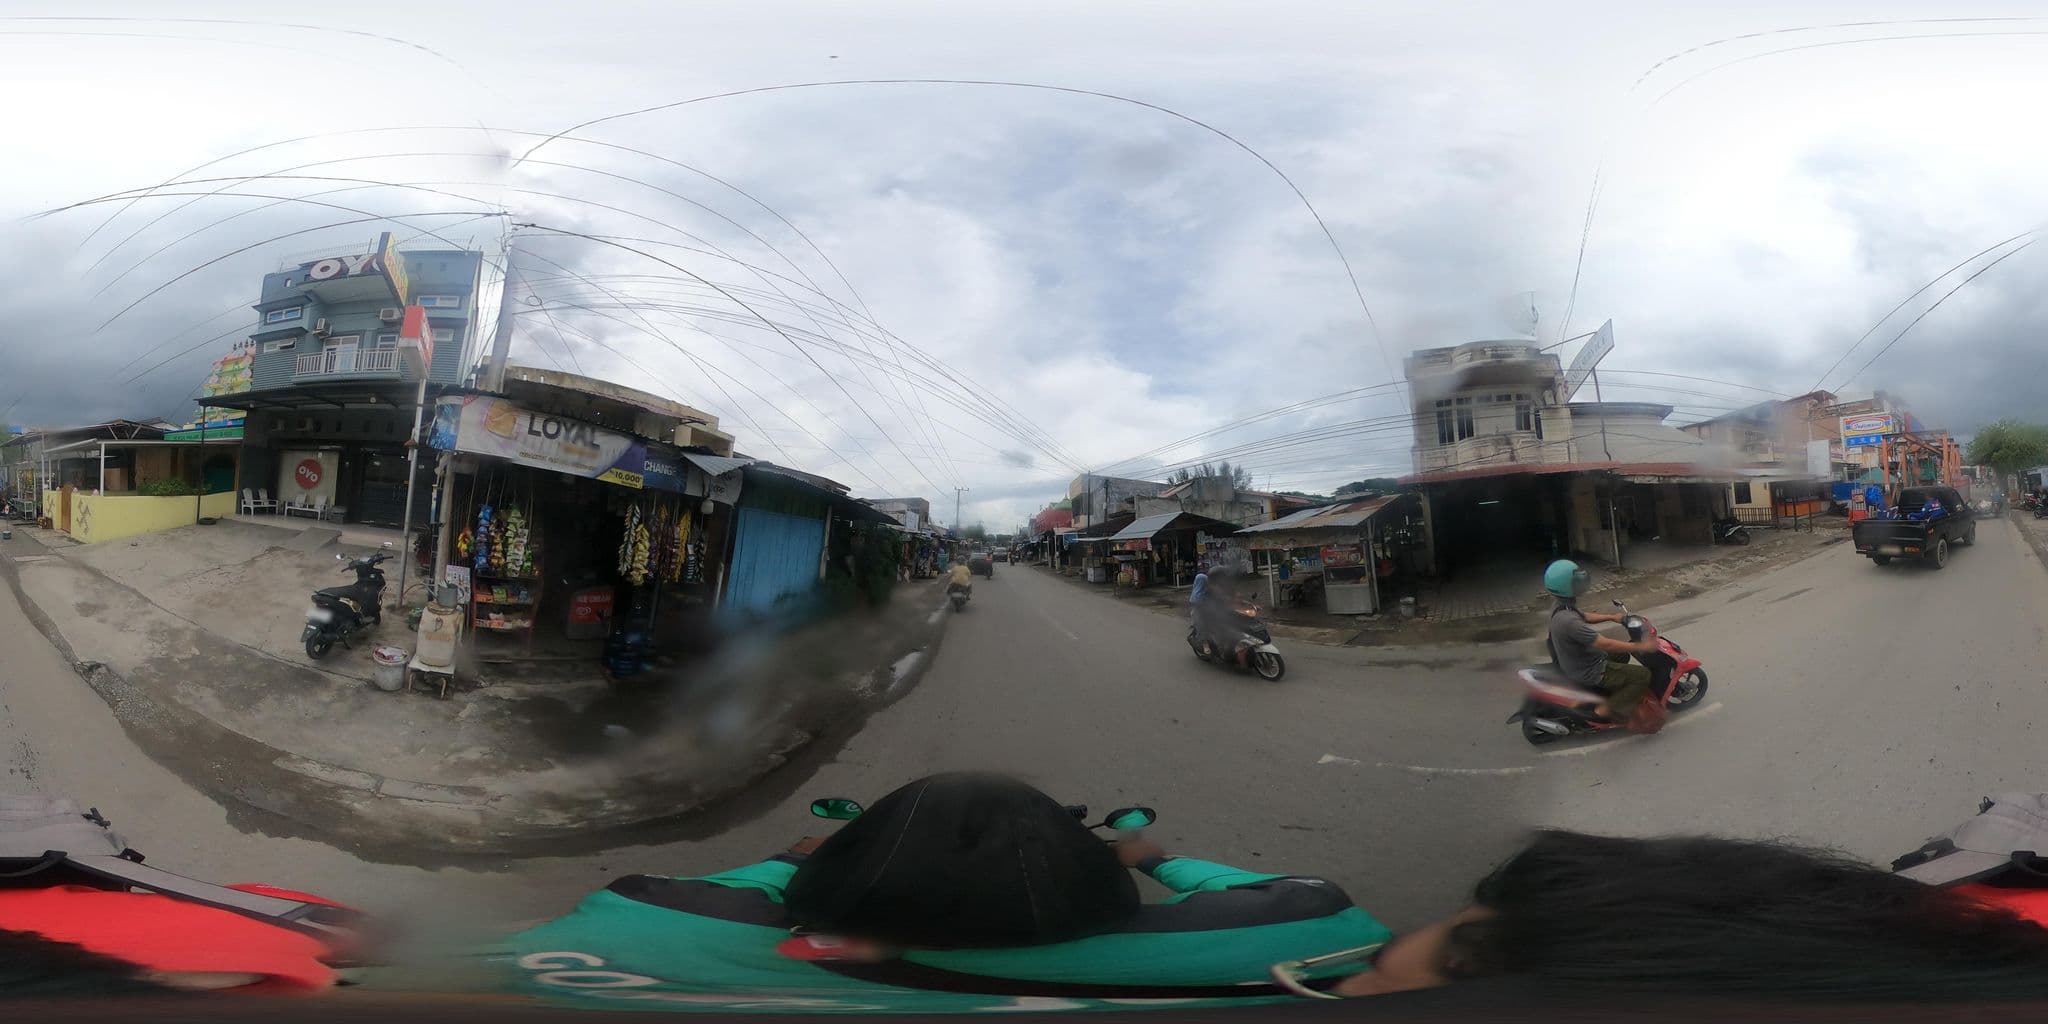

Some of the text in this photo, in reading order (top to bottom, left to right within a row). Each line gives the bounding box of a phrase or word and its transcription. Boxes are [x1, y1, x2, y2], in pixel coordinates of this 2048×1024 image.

[309, 253, 381, 281] OY
[527, 413, 600, 448] LOYAL
[299, 466, 319, 483] OYO
